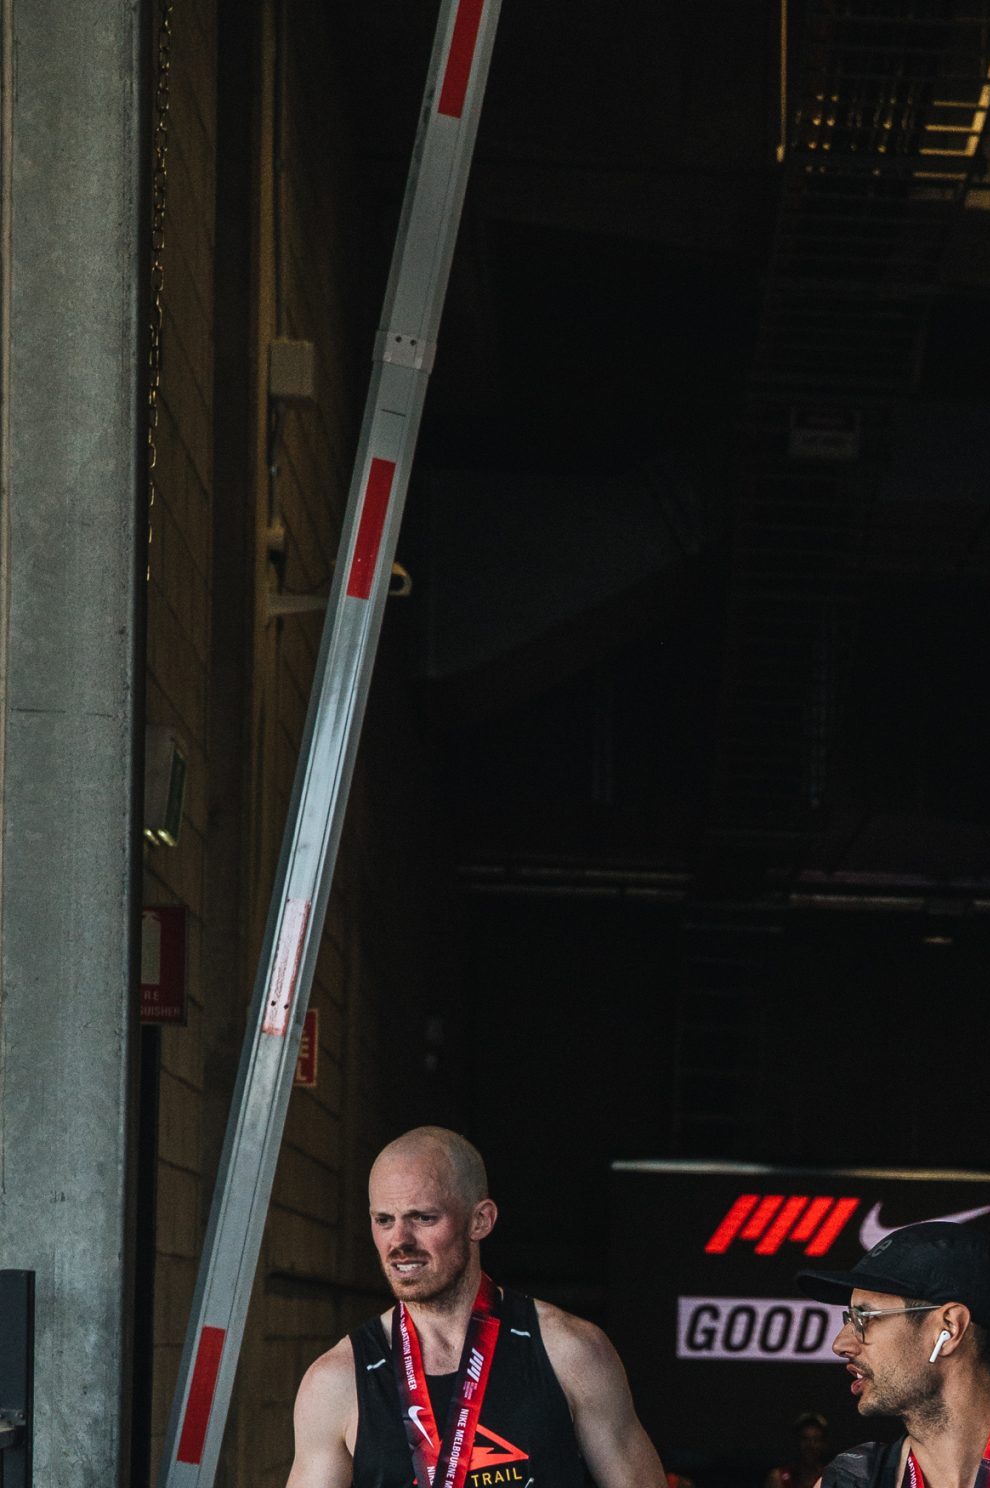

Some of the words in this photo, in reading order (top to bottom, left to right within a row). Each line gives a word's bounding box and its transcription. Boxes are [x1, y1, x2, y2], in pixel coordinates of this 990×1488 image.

[685, 1304, 830, 1354] GOOD
[404, 1355, 417, 1391] FINISHER
[457, 1408, 470, 1428] NIKE
[446, 1430, 466, 1479] MELBOURNE
[471, 1467, 523, 1488] TRAIL
